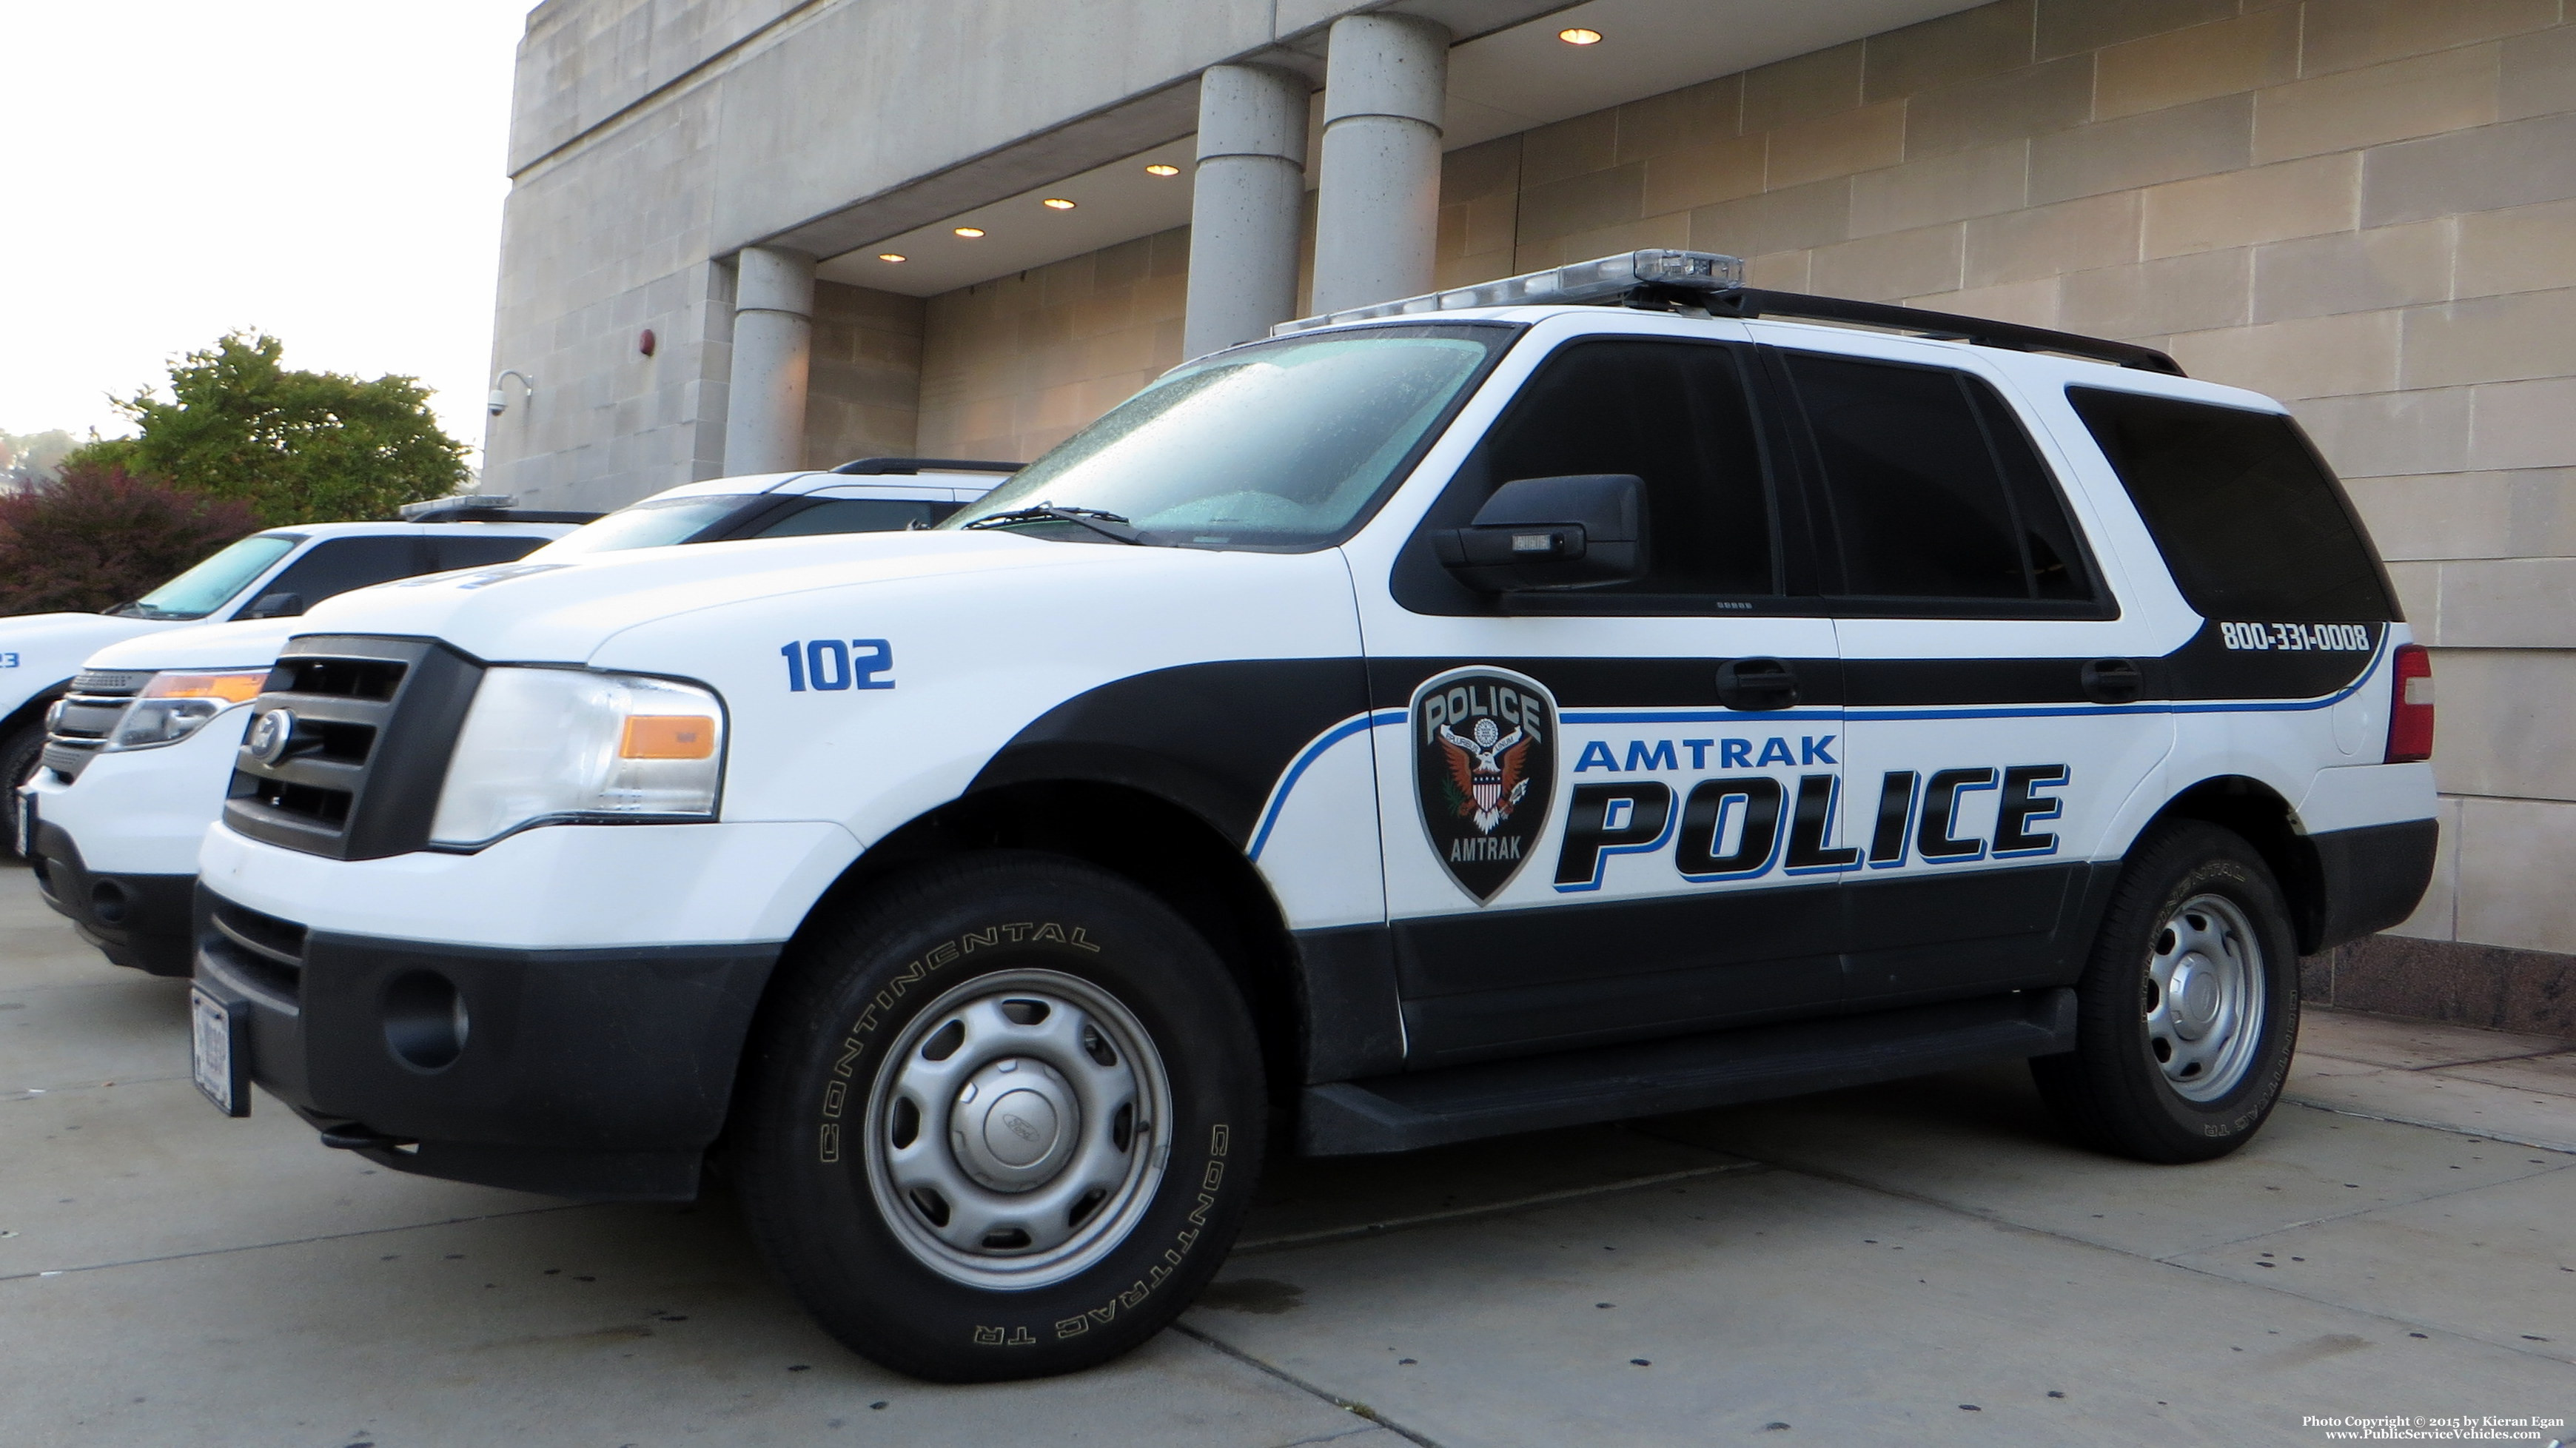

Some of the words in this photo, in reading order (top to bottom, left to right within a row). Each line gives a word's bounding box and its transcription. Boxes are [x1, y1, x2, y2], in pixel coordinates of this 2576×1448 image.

[0, 651, 20, 668] 3
[2221, 622, 2369, 651] 800-331-0008
[780, 638, 895, 692] 102
[1425, 684, 1542, 746] POLICE
[1573, 734, 1839, 773] AMTRAK
[1449, 835, 1522, 863] AMTRAK
[1552, 763, 2072, 894] POLICE
[820, 922, 1101, 1163] CONTINENTAL
[1056, 1124, 1230, 1339] CONTITRAC
[973, 1325, 1036, 1346] TR
